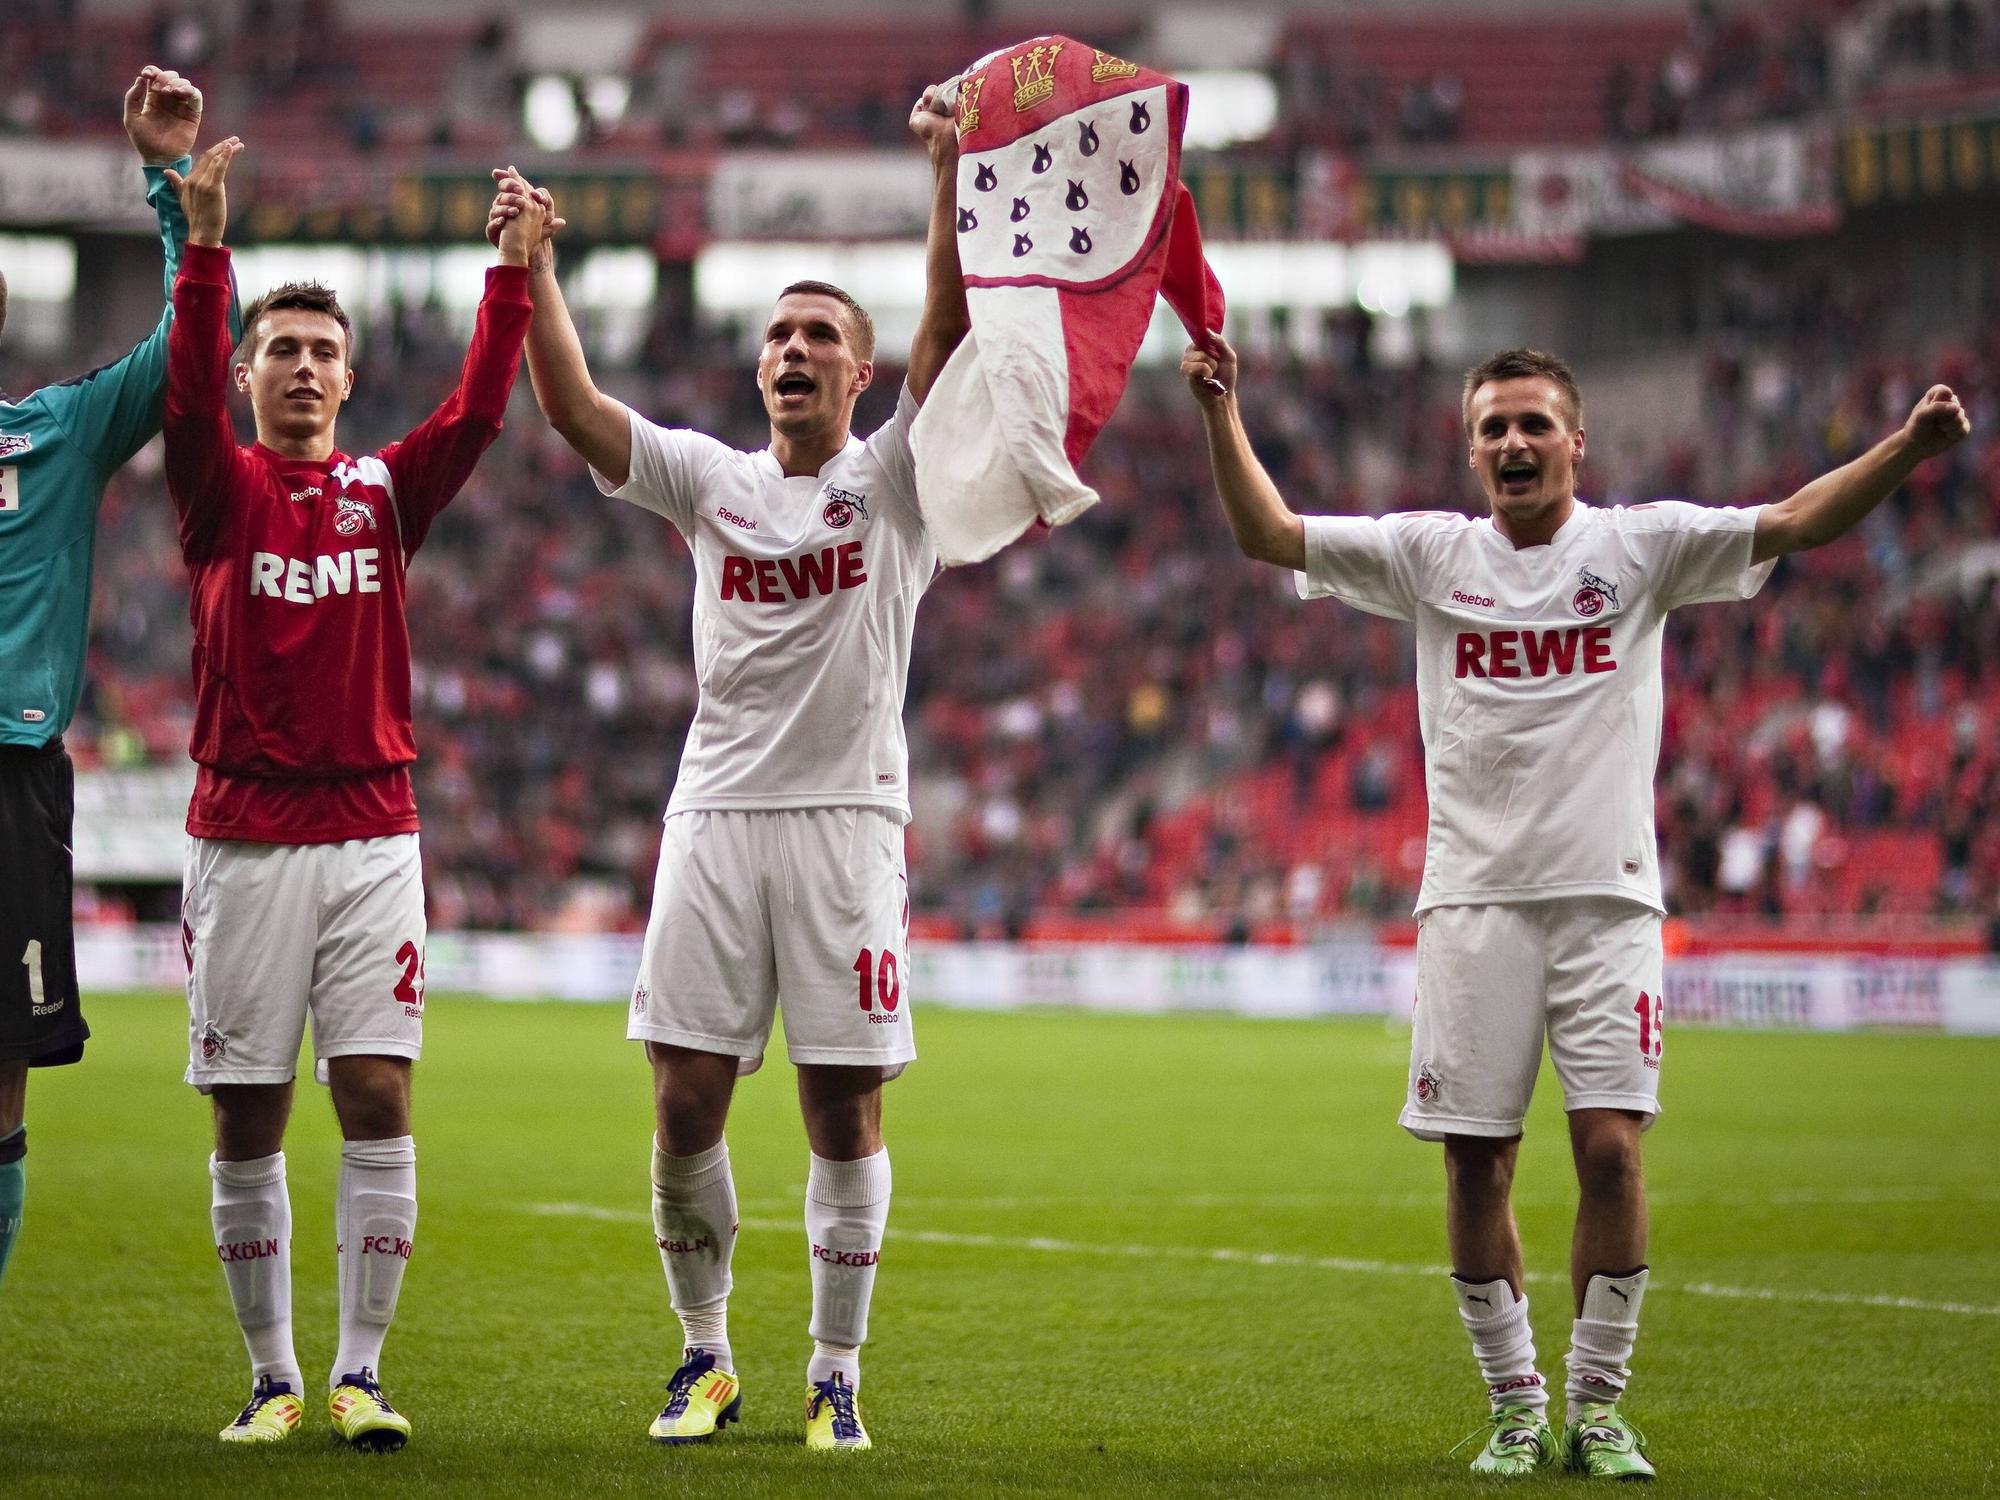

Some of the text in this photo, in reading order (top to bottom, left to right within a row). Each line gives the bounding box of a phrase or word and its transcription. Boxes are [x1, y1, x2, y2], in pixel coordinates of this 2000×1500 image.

[291, 486, 322, 501] Reebo
[716, 507, 757, 531] Reebok
[720, 541, 867, 602] REWE
[1451, 590, 1496, 608] Reebok
[1454, 627, 1617, 678] REWE
[21, 939, 44, 1003] 1
[853, 948, 899, 1012] 10
[868, 1012, 900, 1024] Reebo
[217, 1239, 278, 1262] C.KÖLN
[362, 1236, 413, 1259] FC.KÖ
